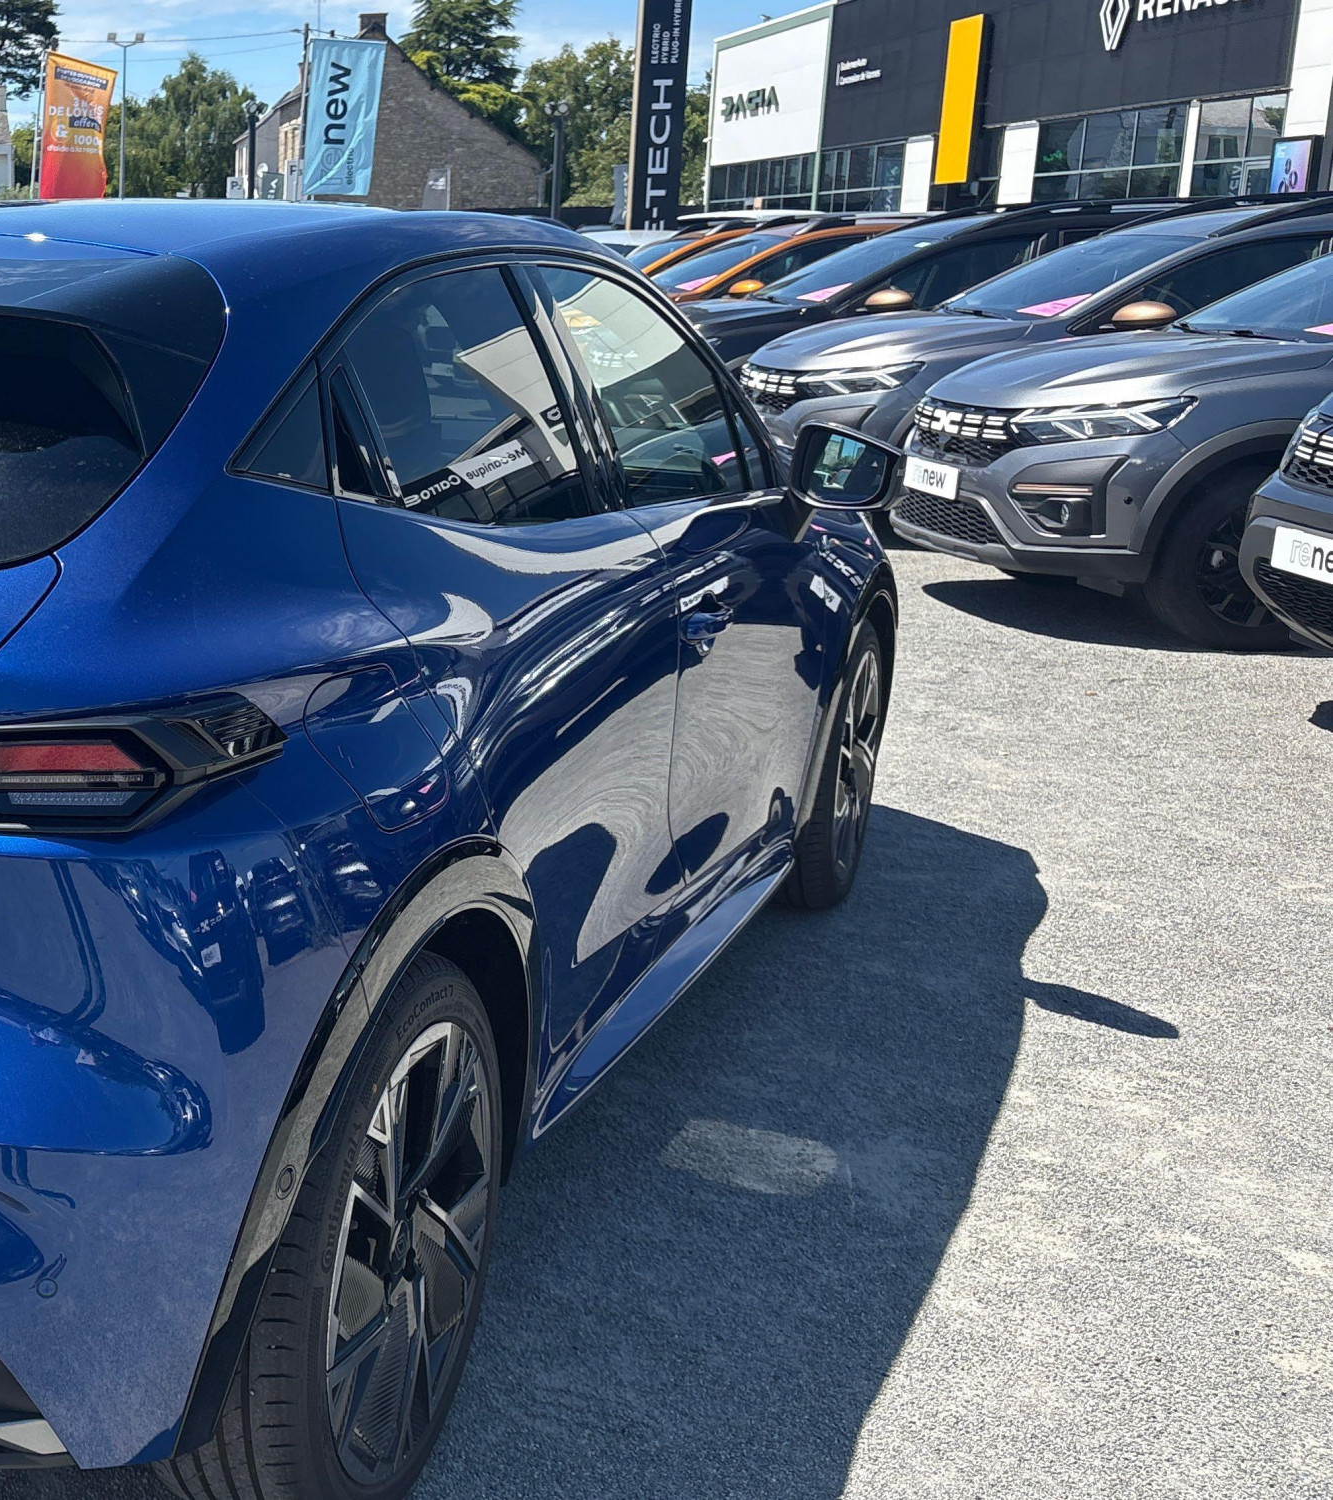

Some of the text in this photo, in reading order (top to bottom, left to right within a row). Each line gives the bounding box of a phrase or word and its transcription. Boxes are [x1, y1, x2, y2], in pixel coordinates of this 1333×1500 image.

[660, 31, 671, 64] HYBRID
[670, 27, 681, 64] PLUG-IN
[48, 106, 64, 116] DE
[720, 86, 779, 117] DACIA
[319, 62, 352, 185] renew
[644, 79, 674, 231] E-TECH
[913, 464, 947, 489] renew
[1290, 539, 1333, 574] rene
[395, 985, 448, 1041] EcoContact
[320, 1136, 359, 1274] Continental
